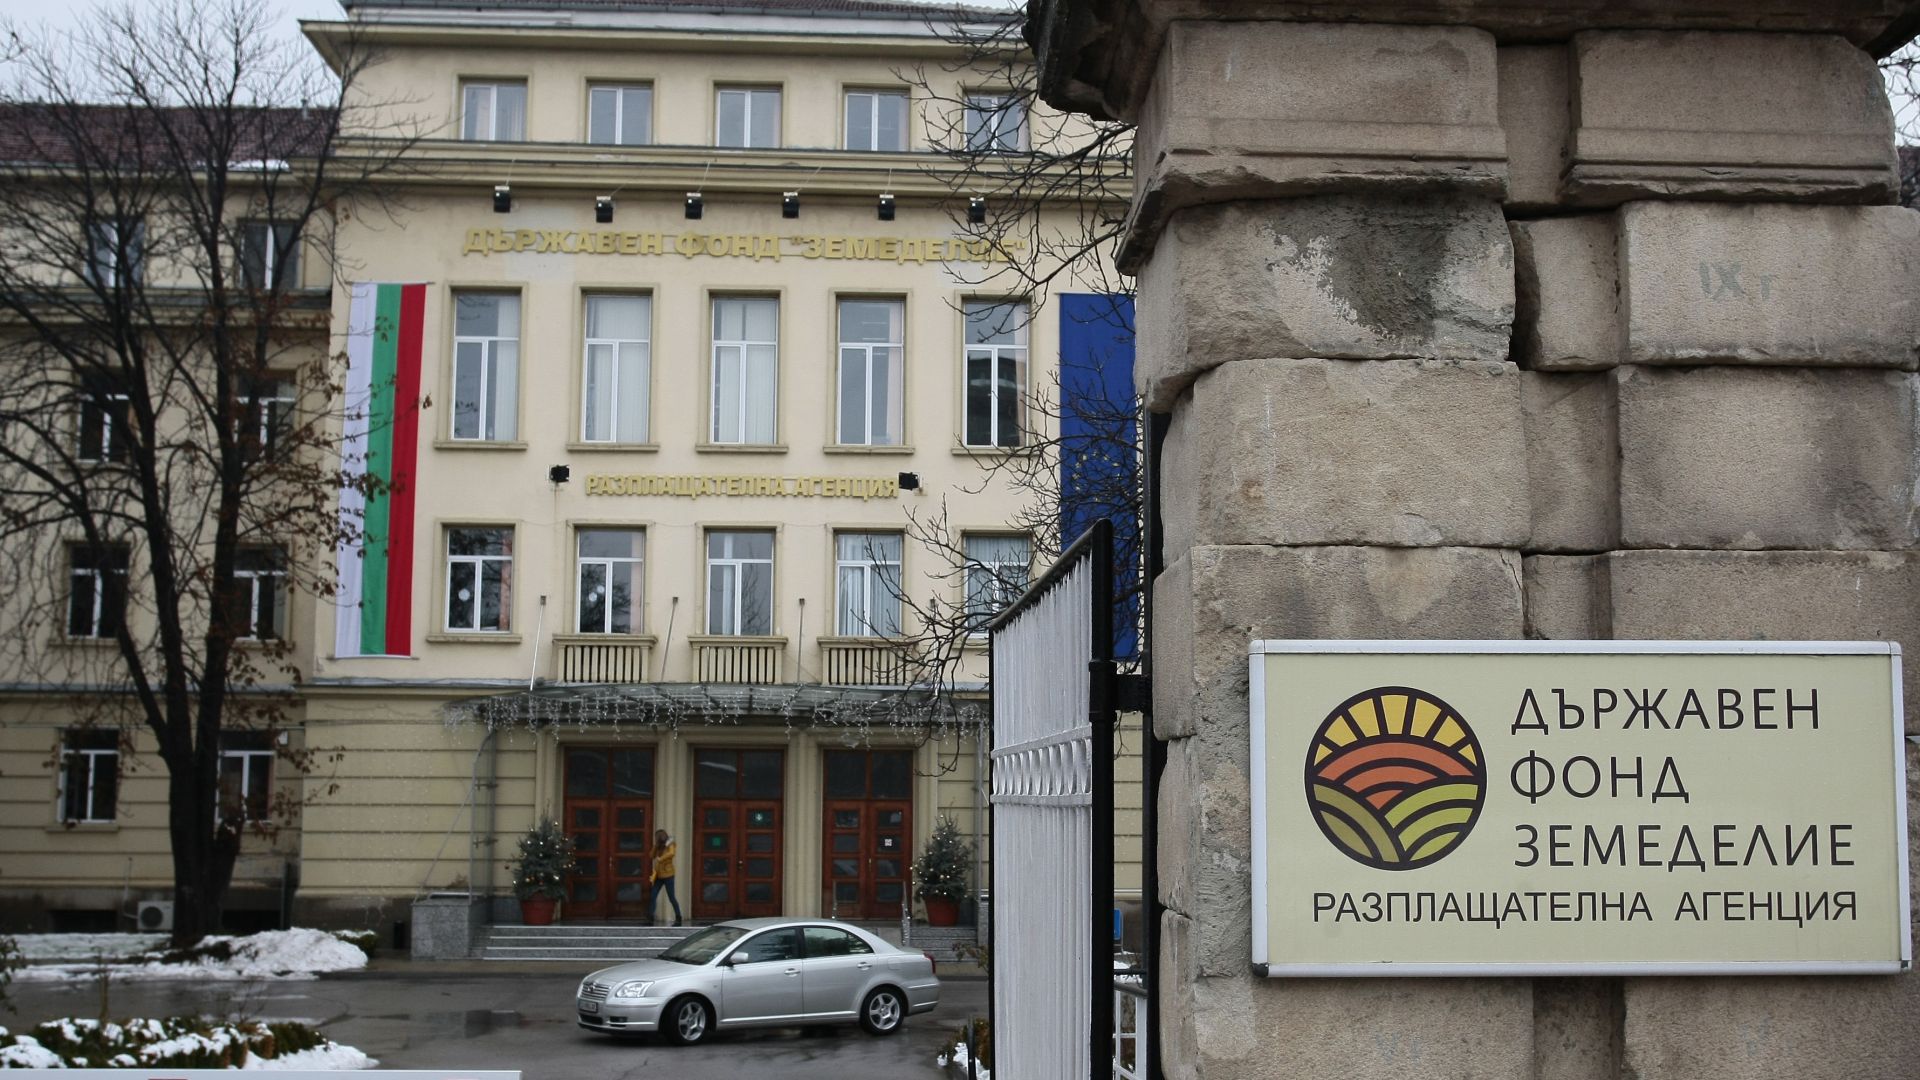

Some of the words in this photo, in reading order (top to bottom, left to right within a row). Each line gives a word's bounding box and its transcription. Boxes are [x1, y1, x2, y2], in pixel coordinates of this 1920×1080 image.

[463, 228, 663, 257] ДЪРЖАВЕН
[674, 231, 780, 262] ФОНД
[585, 474, 785, 500] РАЗПЛАЩАТЕЛНА
[793, 476, 898, 501] АГЕНЦИЯ
[1511, 688, 1819, 735] ДЪРЖАВЕН
[1510, 750, 1689, 804] ФОНД
[1514, 824, 1855, 873] ЗЕМЕДЕЛИЕ
[1313, 892, 1653, 929] РАЗПЛАЩАТЕЛНА
[1674, 891, 1857, 928] АГЕНЦИЯ
